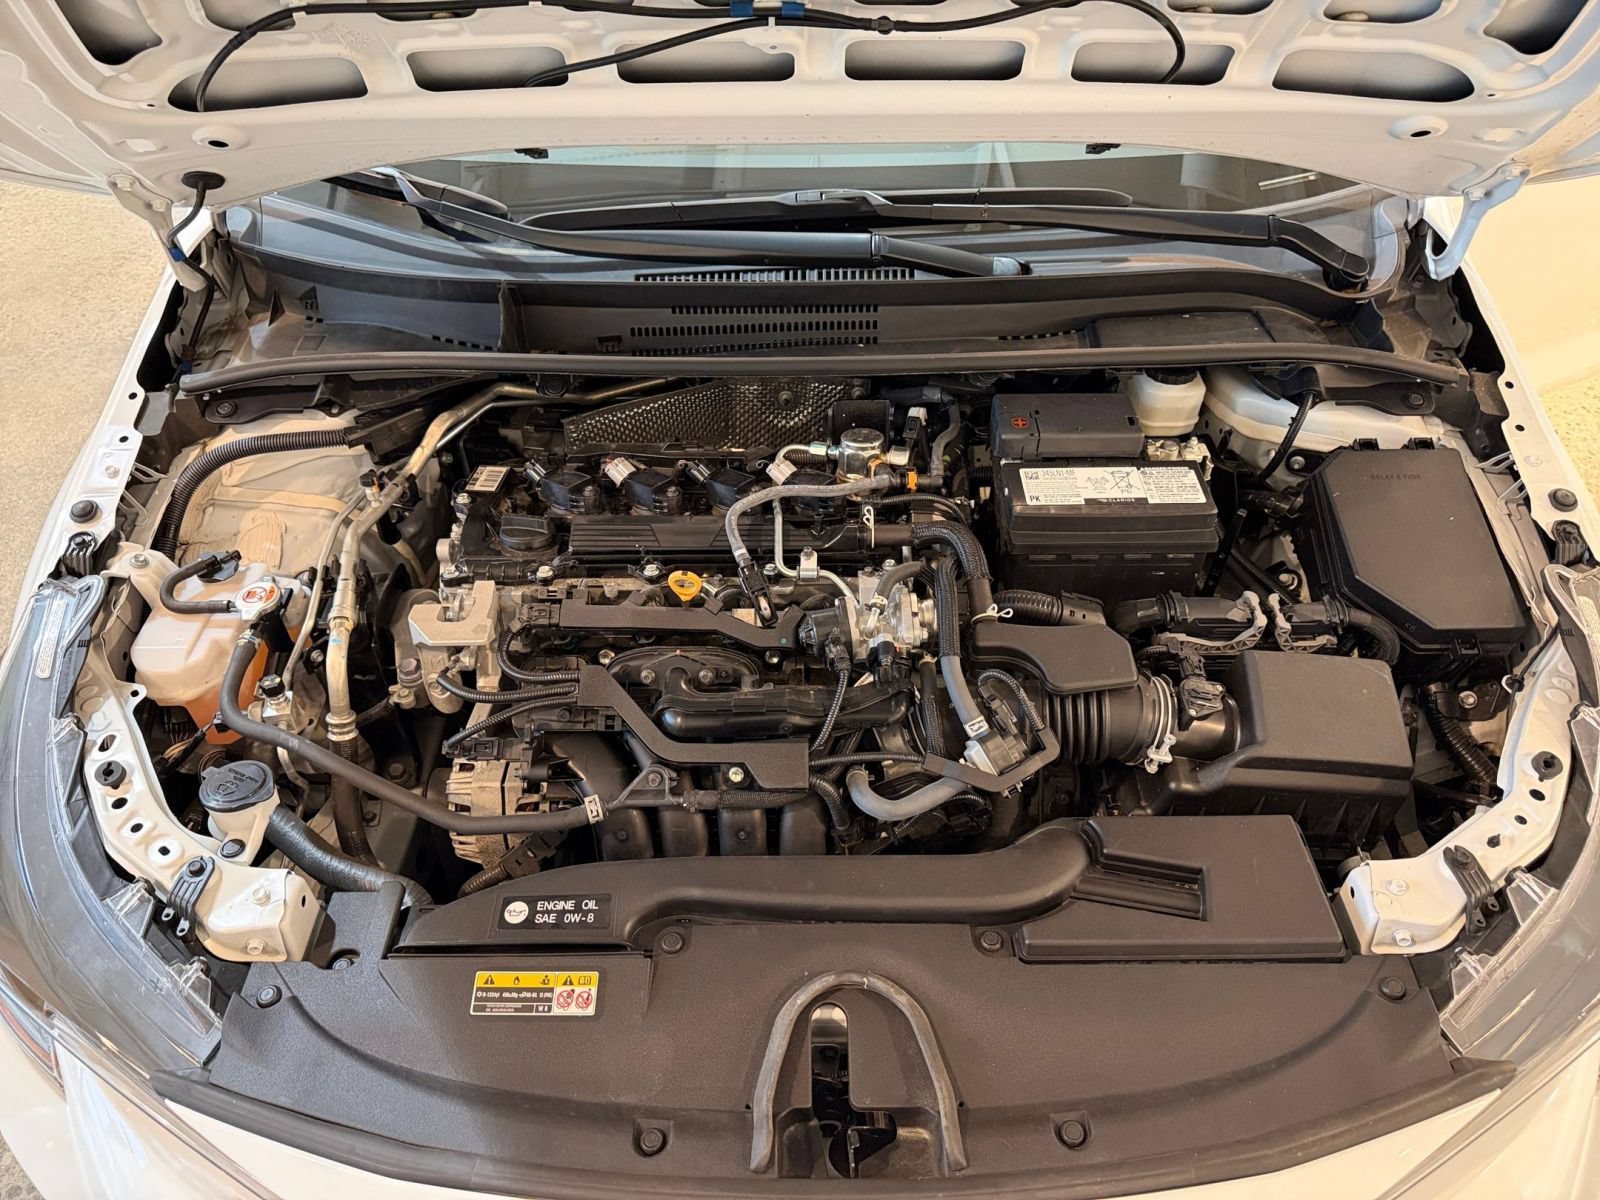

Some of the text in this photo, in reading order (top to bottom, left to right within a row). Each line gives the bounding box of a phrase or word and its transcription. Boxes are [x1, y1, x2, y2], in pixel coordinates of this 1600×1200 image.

[1029, 495, 1041, 503] PK
[536, 899, 599, 911] ENGINE OIL
[534, 912, 594, 924] SAE 0W-8
